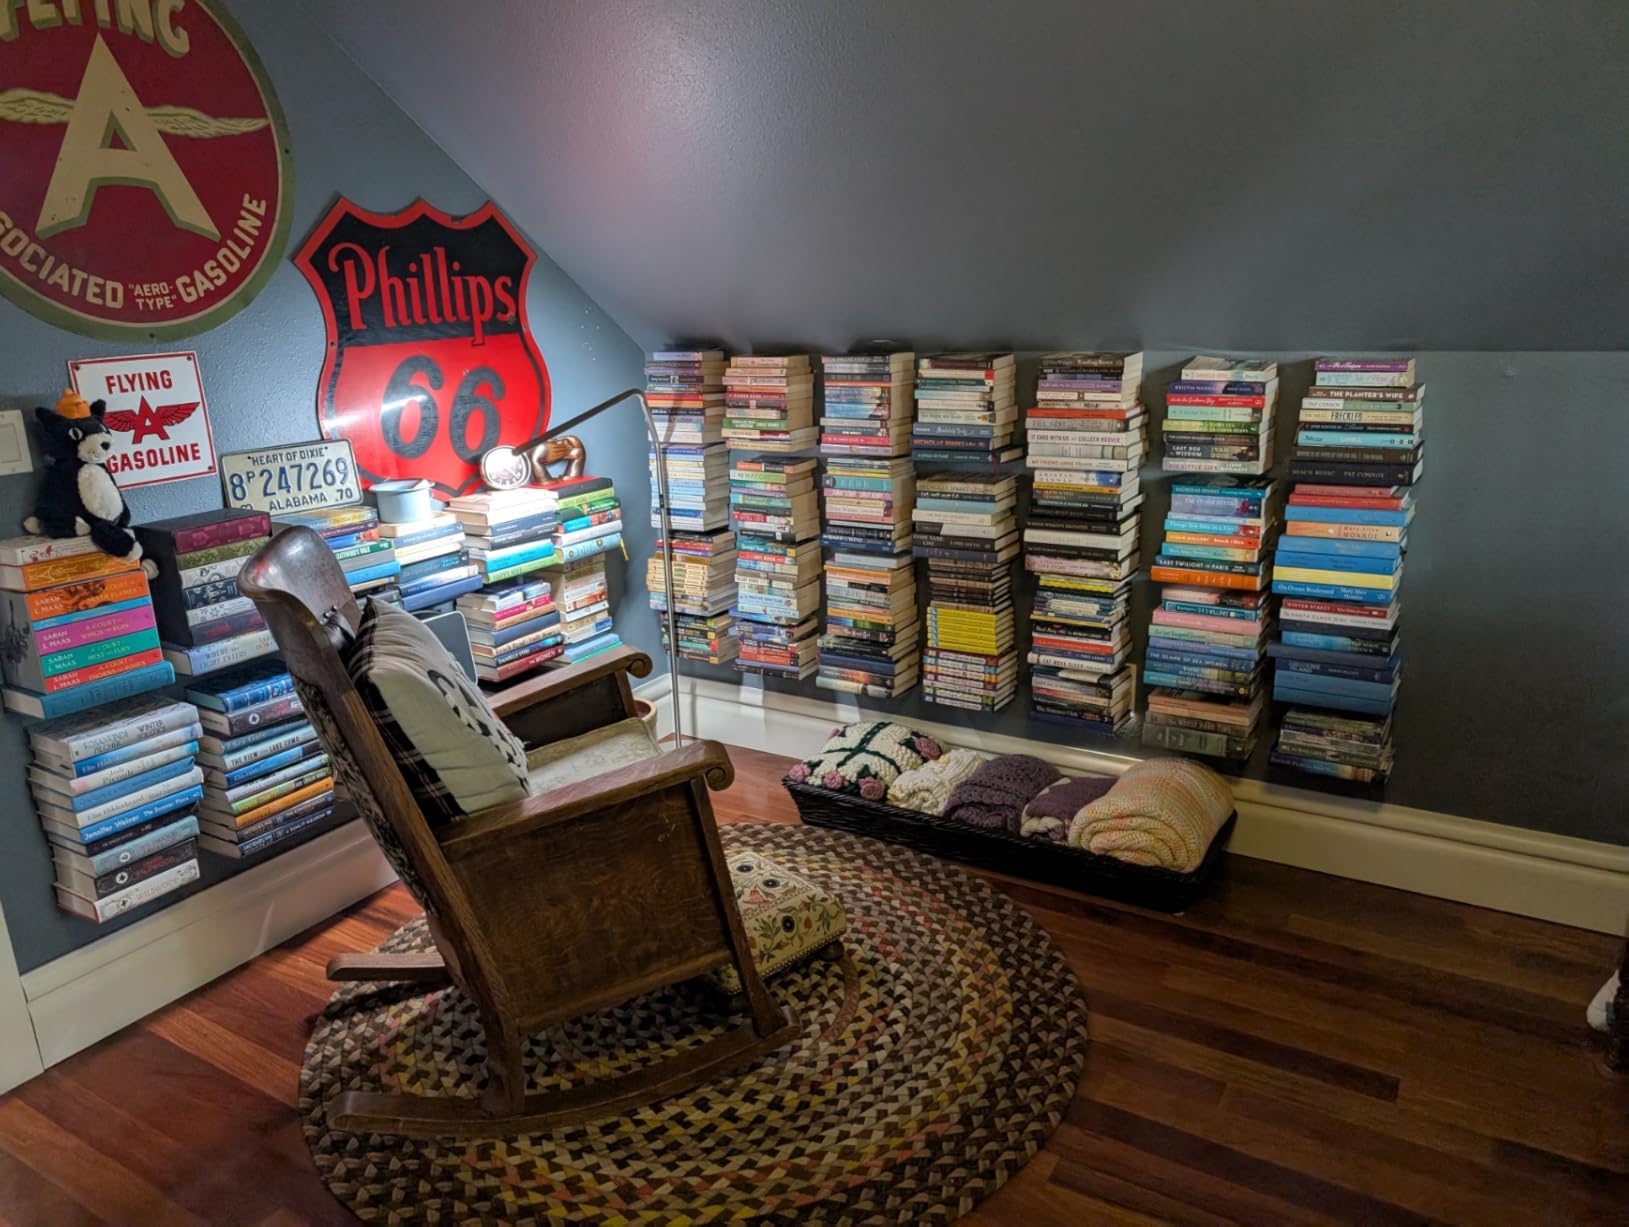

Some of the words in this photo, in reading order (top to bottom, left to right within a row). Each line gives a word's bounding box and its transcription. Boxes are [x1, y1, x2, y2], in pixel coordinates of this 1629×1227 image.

[175, 193, 267, 304] GASOLINE
[328, 242, 516, 346] Phillips
[105, 369, 172, 395] FLYING
[381, 355, 506, 467] 66
[106, 443, 201, 474] GASOLINE
[252, 453, 284, 466] HEART
[286, 451, 297, 461] OF
[300, 447, 325, 459] DIXIE
[269, 492, 327, 511] ALABAMA
[1175, 560, 1203, 568] TWILIGHT
[43, 630, 68, 641] SARAH
[48, 652, 73, 665] SARAH
[53, 671, 78, 682] SARAH
[84, 824, 113, 841] Jennifer
[114, 814, 140, 828] Weiner
